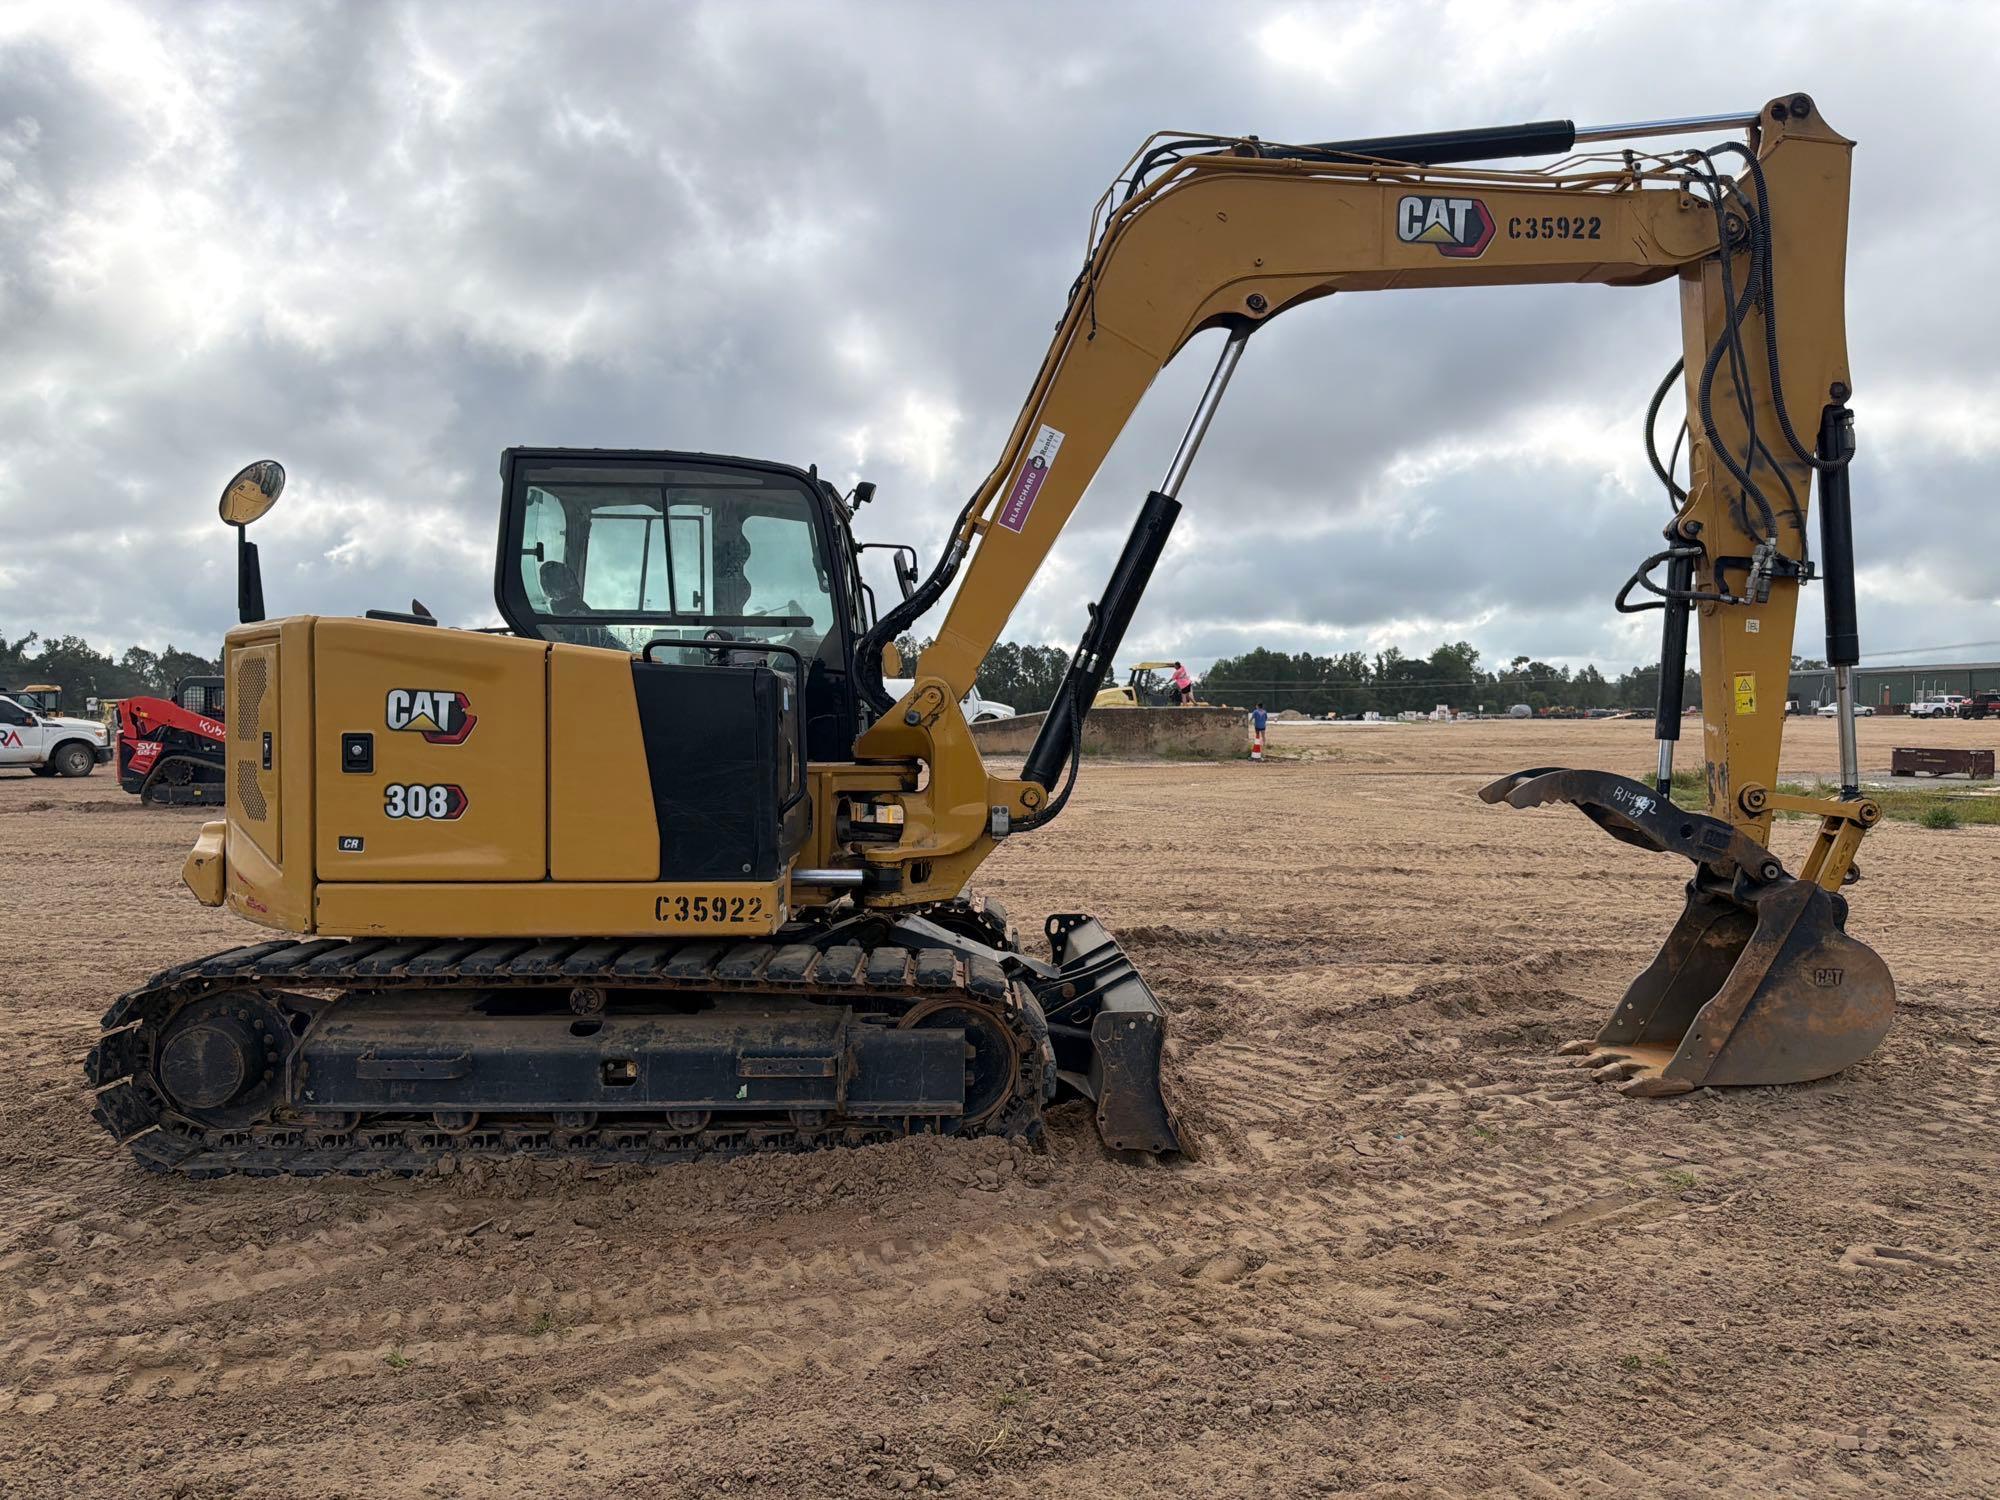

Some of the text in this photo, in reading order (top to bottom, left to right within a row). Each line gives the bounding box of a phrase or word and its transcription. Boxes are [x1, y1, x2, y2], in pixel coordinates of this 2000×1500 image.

[1398, 196, 1473, 244] CAT
[1508, 216, 1601, 239] C35922
[1008, 472, 1037, 524] BLANCHARD
[1040, 432, 1056, 456] Rental
[387, 689, 456, 732] CAT
[136, 742, 161, 750] SVL
[386, 784, 448, 818] 308
[343, 838, 359, 849] CR
[655, 896, 762, 922] C35922
[1815, 968, 1843, 987] CAT
